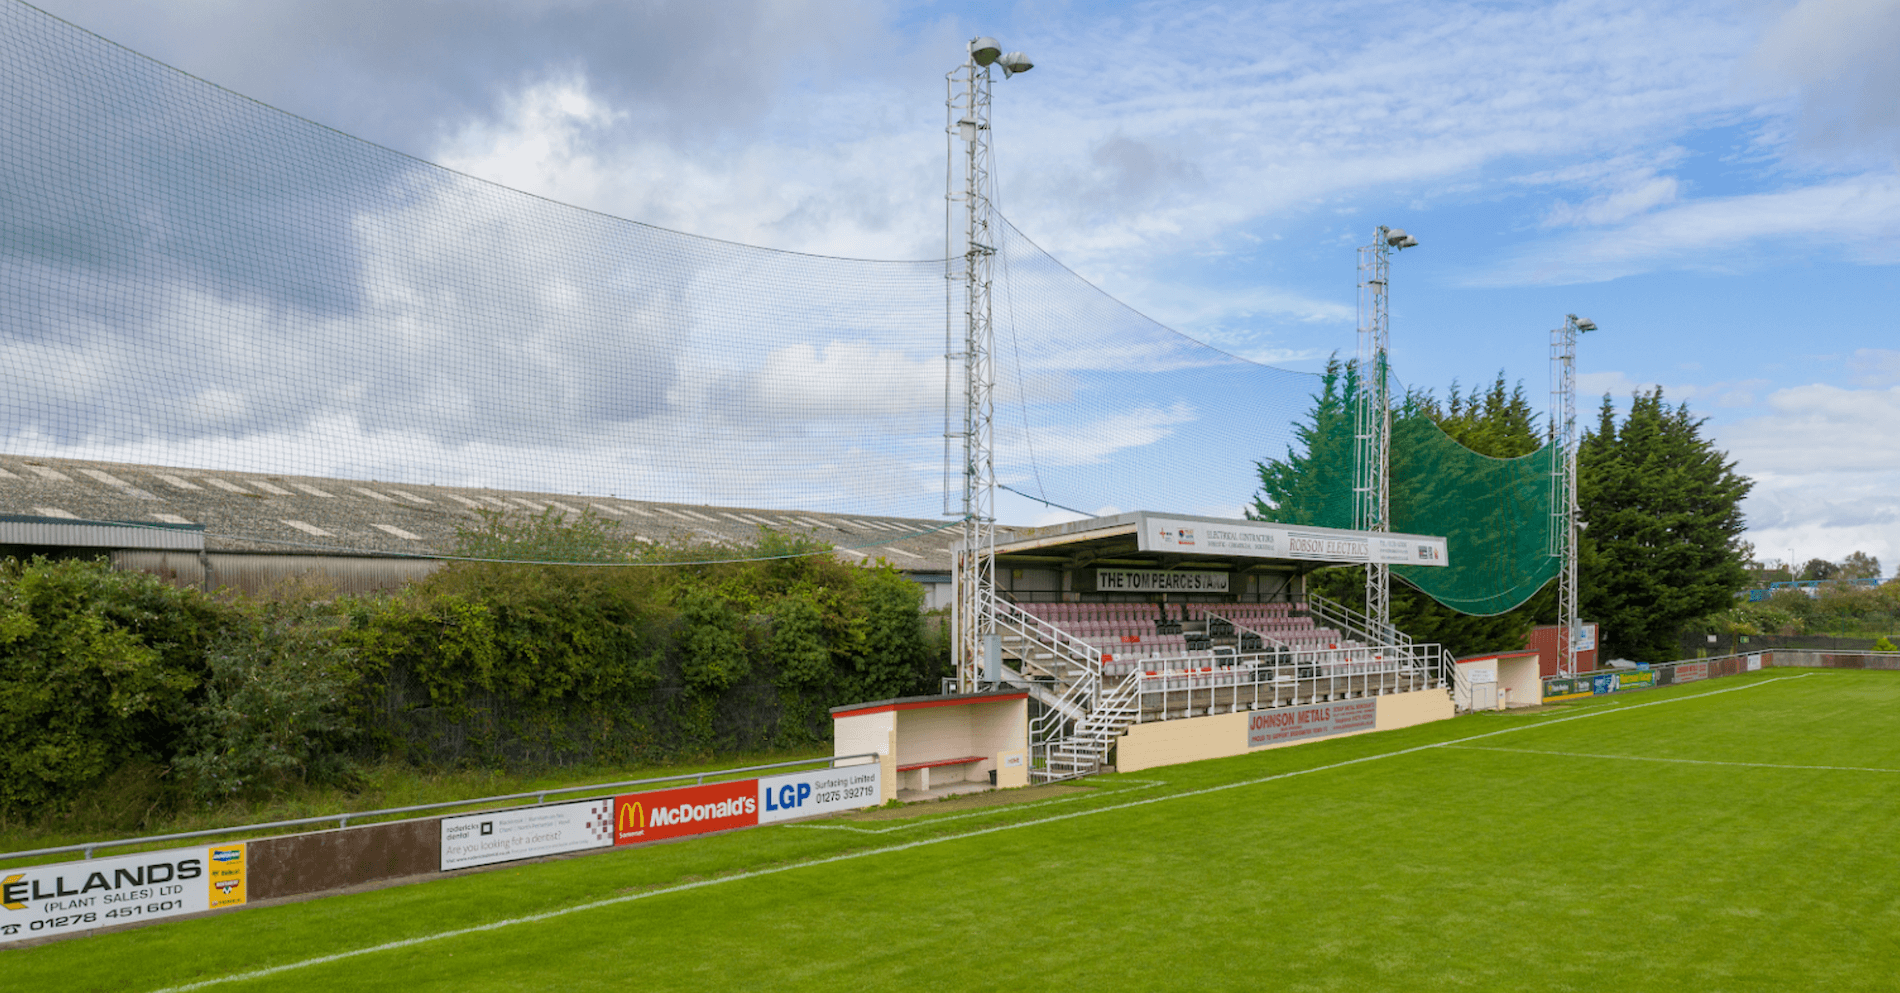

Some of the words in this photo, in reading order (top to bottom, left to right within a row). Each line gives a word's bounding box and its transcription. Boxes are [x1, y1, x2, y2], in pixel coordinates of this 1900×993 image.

[1289, 538, 1324, 552] ROBSON
[1327, 541, 1369, 556] ELECTRICS
[1100, 572, 1123, 588] THE
[1127, 573, 1150, 588] TOM
[1152, 573, 1193, 589] PEARCE
[1194, 574, 1227, 589] STAND
[1250, 712, 1294, 730] JOHNSON
[1297, 707, 1331, 724] METALS
[815, 778, 848, 790] Surfacing
[850, 774, 876, 785] Limited
[766, 782, 811, 812] LGP
[816, 791, 840, 804] 01275
[844, 785, 874, 799] 392719
[650, 796, 756, 827] McDonald's
[446, 823, 479, 832] rodericks
[446, 832, 469, 840] dental
[446, 845, 461, 855] Are
[462, 844, 479, 855] you
[480, 838, 510, 851] looking
[511, 835, 524, 846] for
[532, 830, 562, 843] dentist?
[44, 897, 97, 914] (PLANT
[103, 887, 154, 904] SALES)
[160, 884, 183, 896] LTD
[30, 912, 97, 931] 01278
